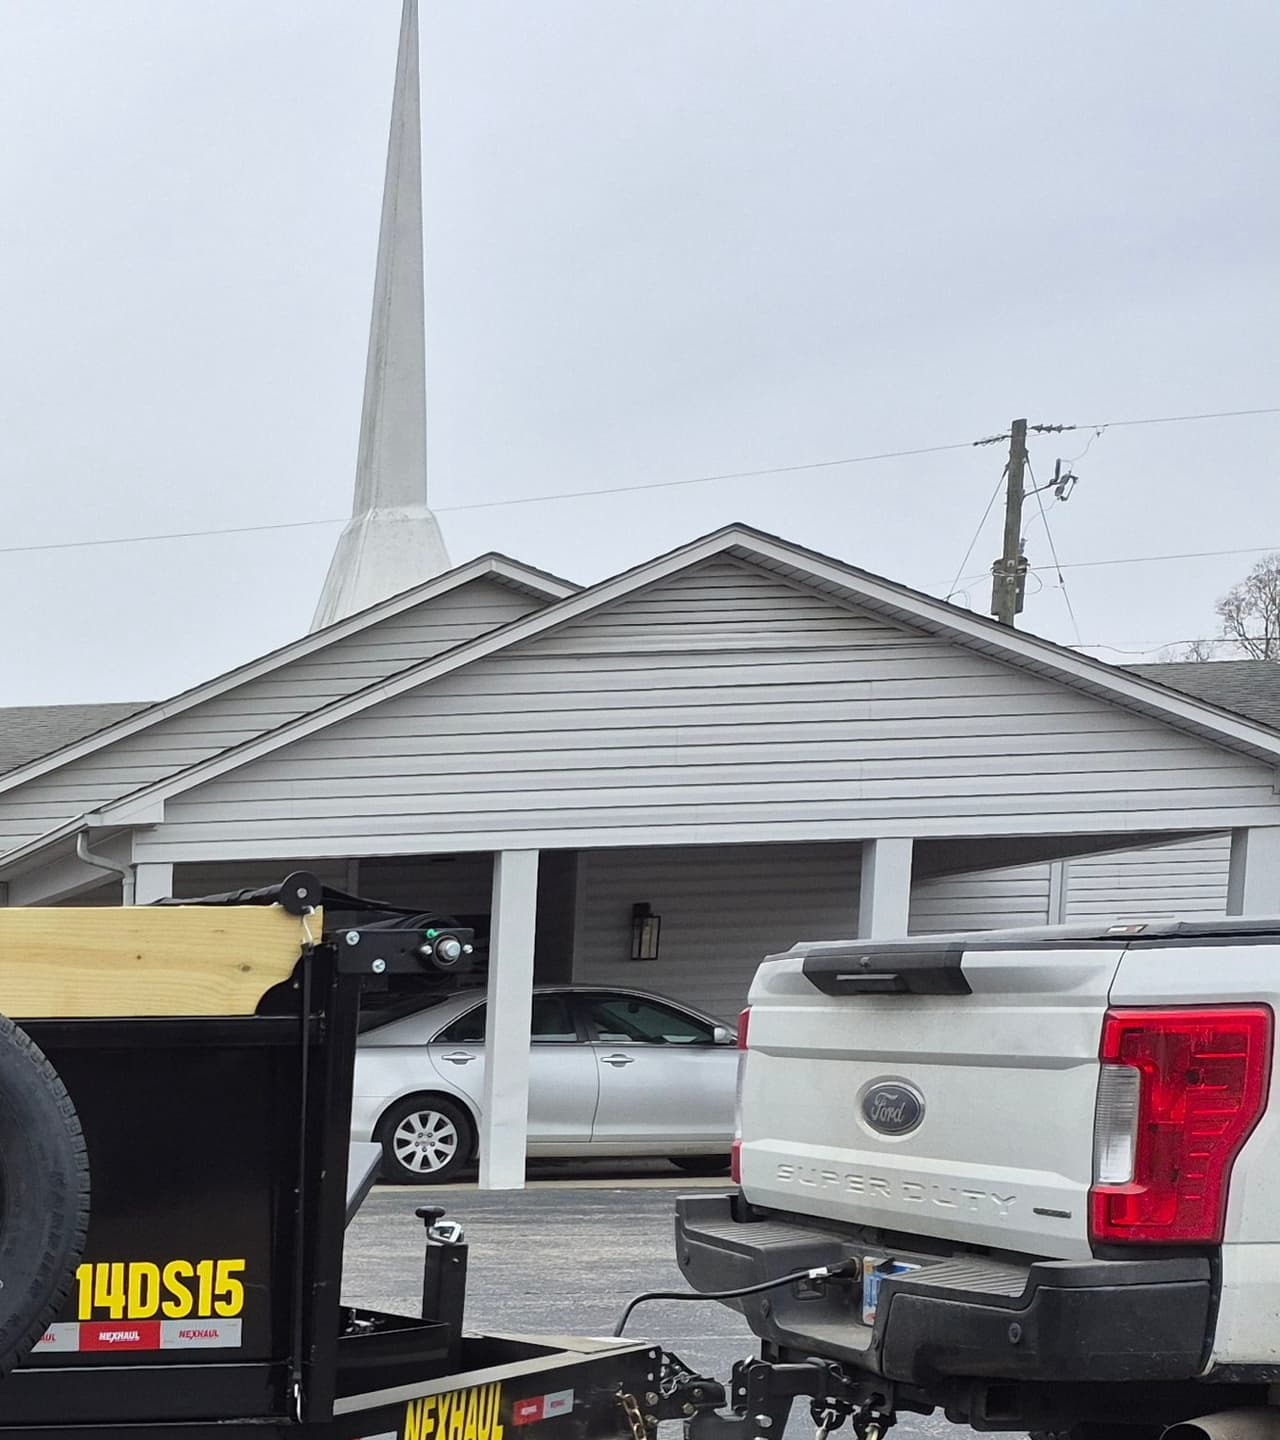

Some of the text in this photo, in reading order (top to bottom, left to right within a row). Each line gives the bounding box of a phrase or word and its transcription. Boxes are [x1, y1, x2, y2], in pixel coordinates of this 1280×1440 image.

[871, 1091, 906, 1122] Ford
[776, 1163, 1016, 1216] SUPER DUTY
[75, 1259, 246, 1321] 14DS15
[98, 1330, 140, 1343] NEXHAUL
[178, 1329, 219, 1341] NEXHAUL
